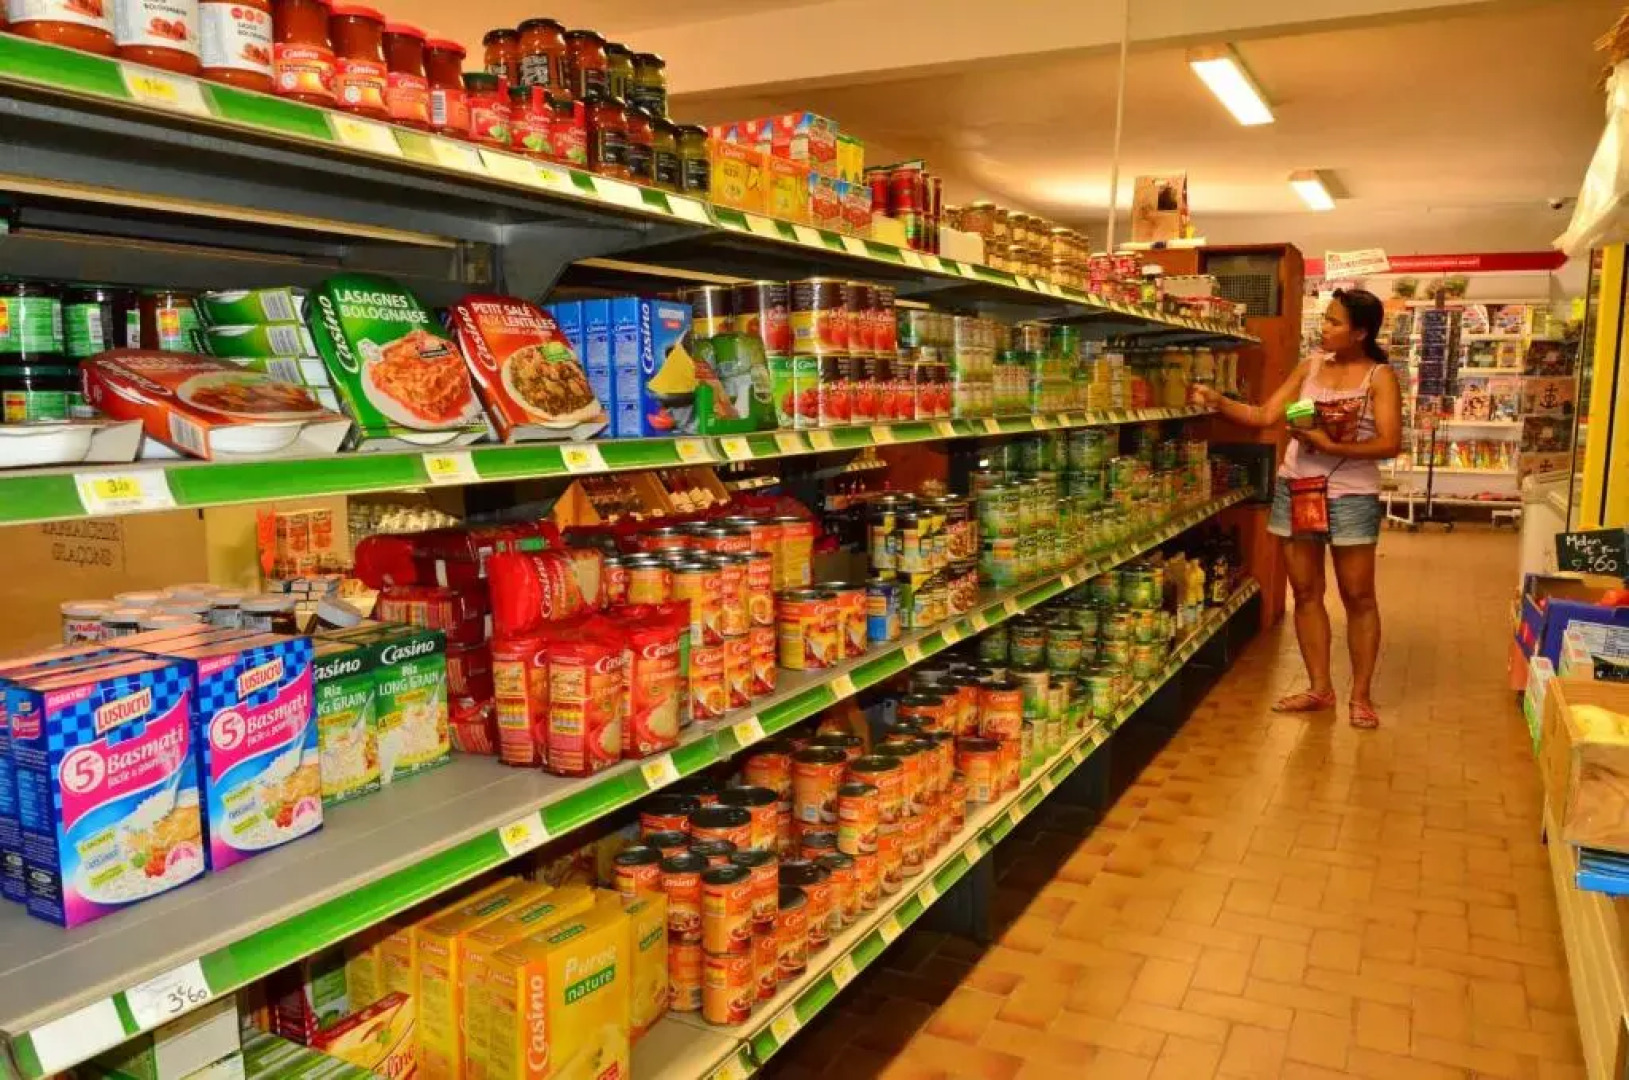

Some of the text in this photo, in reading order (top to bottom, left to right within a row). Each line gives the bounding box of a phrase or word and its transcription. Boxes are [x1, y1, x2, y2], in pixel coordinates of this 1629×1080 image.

[334, 288, 408, 308] LASAGNES
[470, 302, 503, 315] PETIT
[341, 304, 429, 324] BOLOGNAISE
[505, 316, 556, 330] LENTILLES
[318, 295, 359, 374] Casino
[457, 306, 498, 371] Casino
[642, 303, 655, 375] Casino
[533, 556, 553, 618] Casino
[381, 639, 435, 665] Casino
[313, 658, 361, 681] asino
[379, 679, 408, 696] LONG
[409, 670, 439, 688] GRAIN
[324, 685, 343, 698] Riz
[333, 691, 367, 711] GRAIN
[98, 690, 150, 731] Lustucru
[222, 715, 240, 747] 5
[247, 690, 308, 735] Basmati
[75, 754, 95, 790] 5
[107, 724, 184, 774] Basmati
[567, 966, 614, 1002] nature
[527, 974, 549, 1071] Casino
